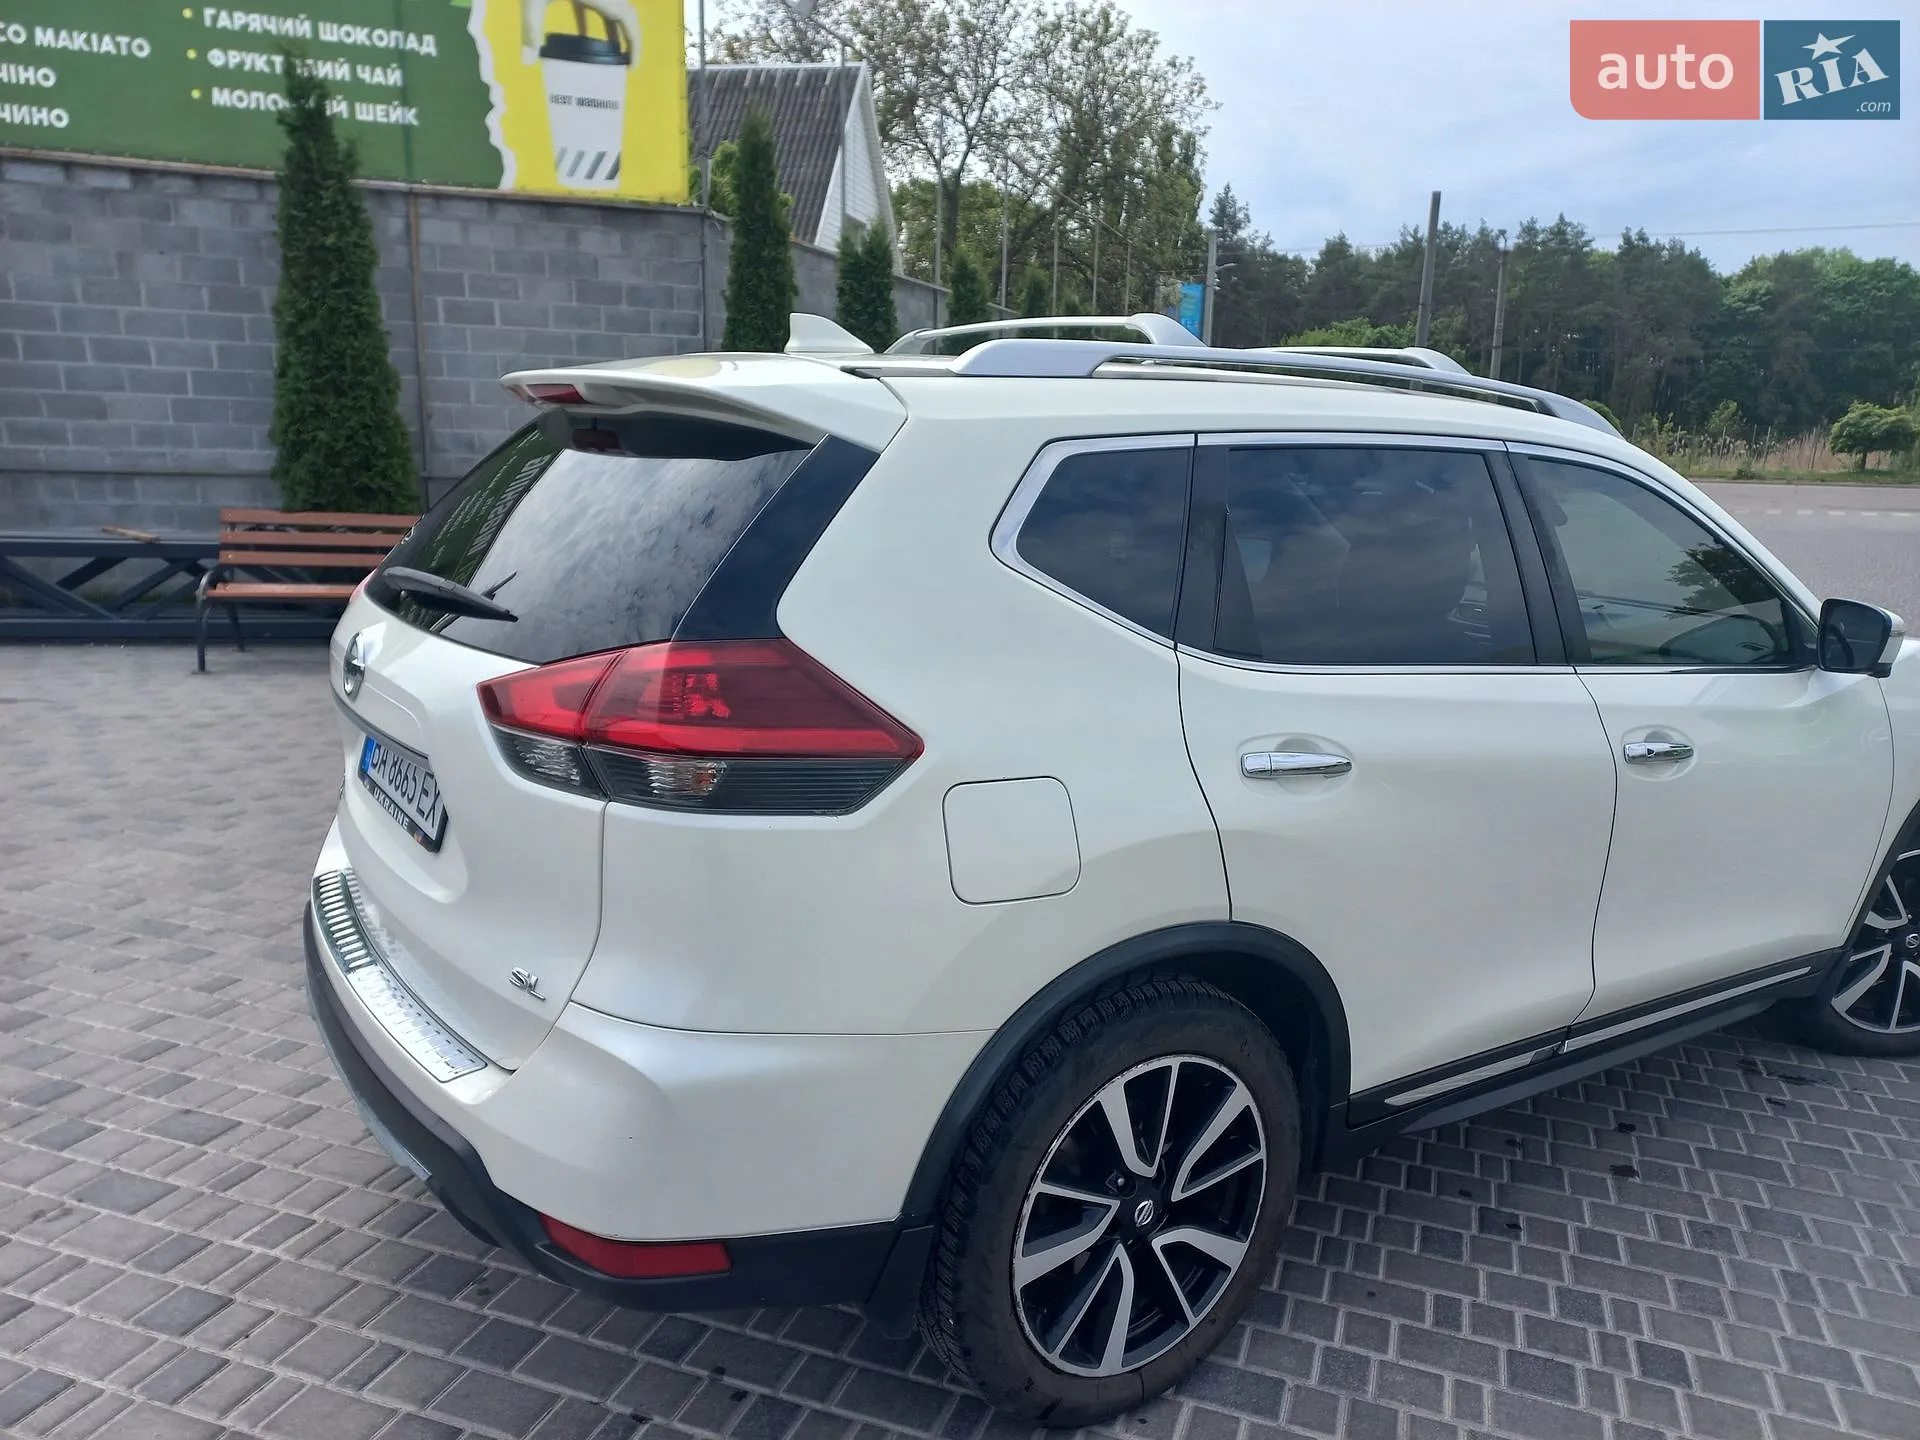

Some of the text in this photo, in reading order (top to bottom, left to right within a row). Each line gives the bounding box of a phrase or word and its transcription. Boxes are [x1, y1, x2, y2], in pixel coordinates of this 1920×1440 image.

[34, 25, 152, 58] МАКІАТО
[203, 7, 438, 57] ГАРЯЧИЙ ШОКОЛАД
[356, 63, 405, 88] ЧАЙ
[354, 100, 420, 127] ШЕЙК
[373, 786, 410, 830] UKRAINE
[508, 966, 547, 1001] SL
